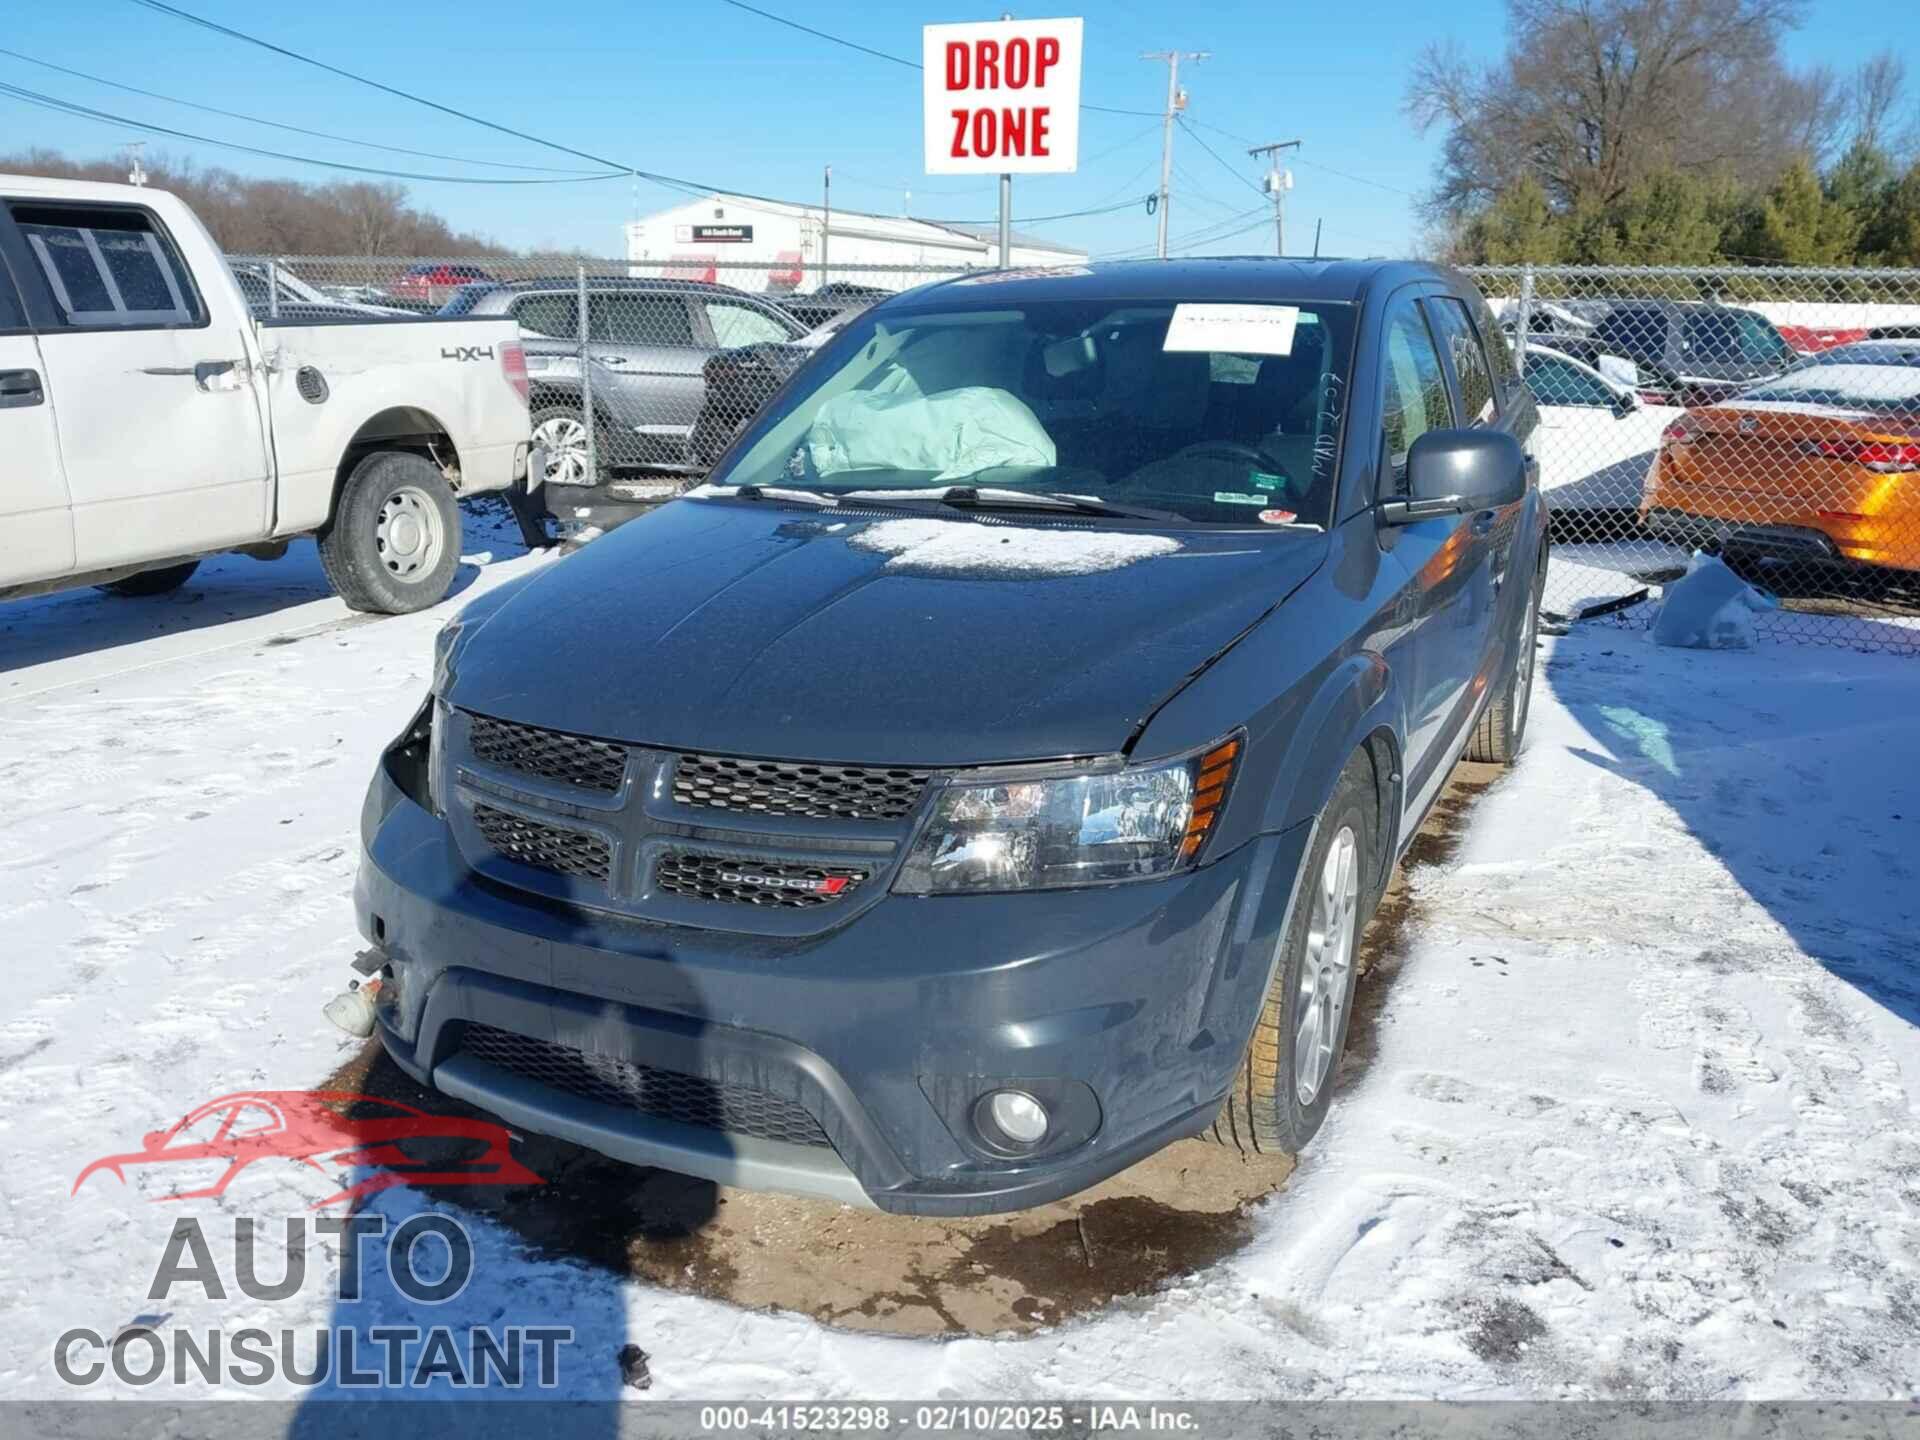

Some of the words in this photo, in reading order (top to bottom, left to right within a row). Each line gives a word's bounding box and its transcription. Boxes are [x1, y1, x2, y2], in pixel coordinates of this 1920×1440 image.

[946, 37, 1060, 91] DROP
[950, 107, 1050, 158] ZONE
[721, 872, 829, 891] DODGE
